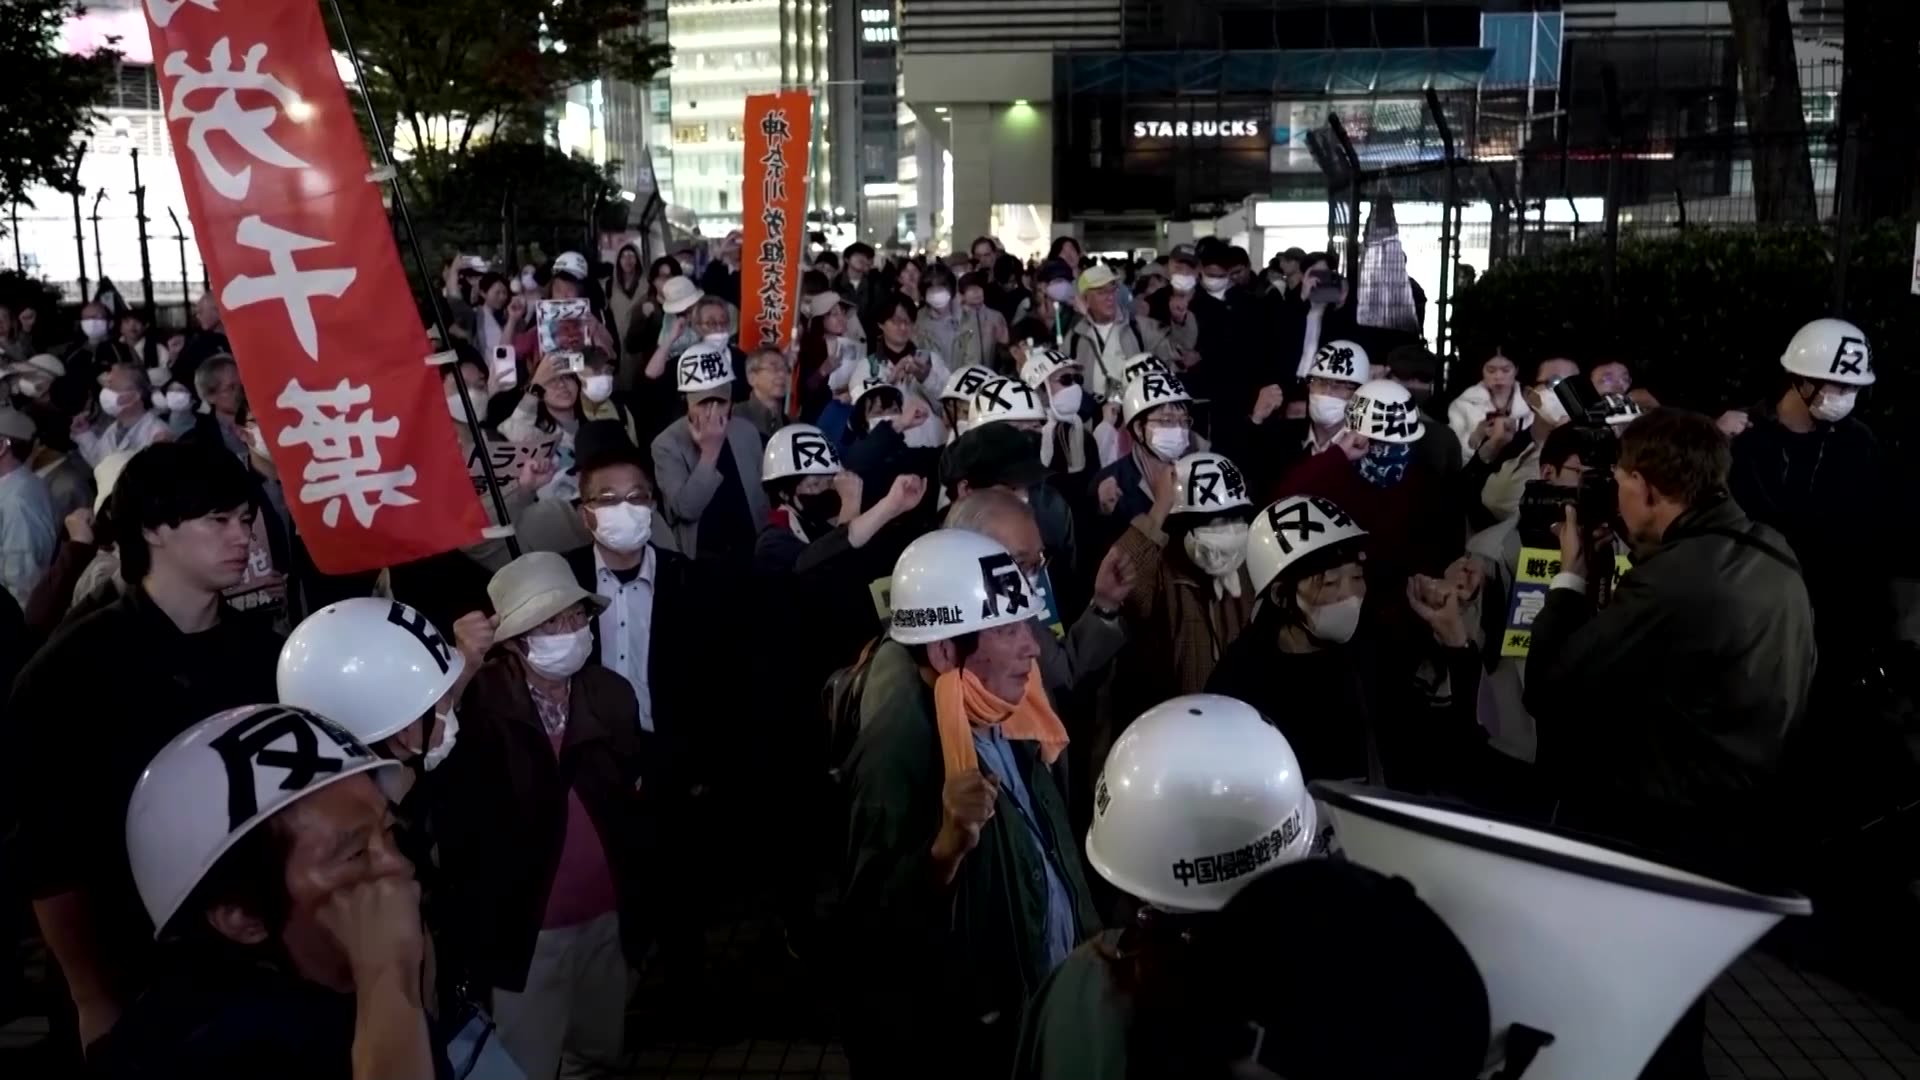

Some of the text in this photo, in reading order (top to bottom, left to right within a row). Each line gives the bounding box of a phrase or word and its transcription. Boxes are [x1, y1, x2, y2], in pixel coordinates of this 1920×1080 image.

[1133, 120, 1259, 138] STARBUCKS
[680, 352, 728, 385] 反戦
[1830, 336, 1872, 375] 反
[954, 367, 993, 395] 反
[791, 431, 840, 470] 反
[979, 552, 1034, 619] 反
[208, 706, 370, 834] 反
[1172, 808, 1302, 887] 中国侵略戦争阻止
